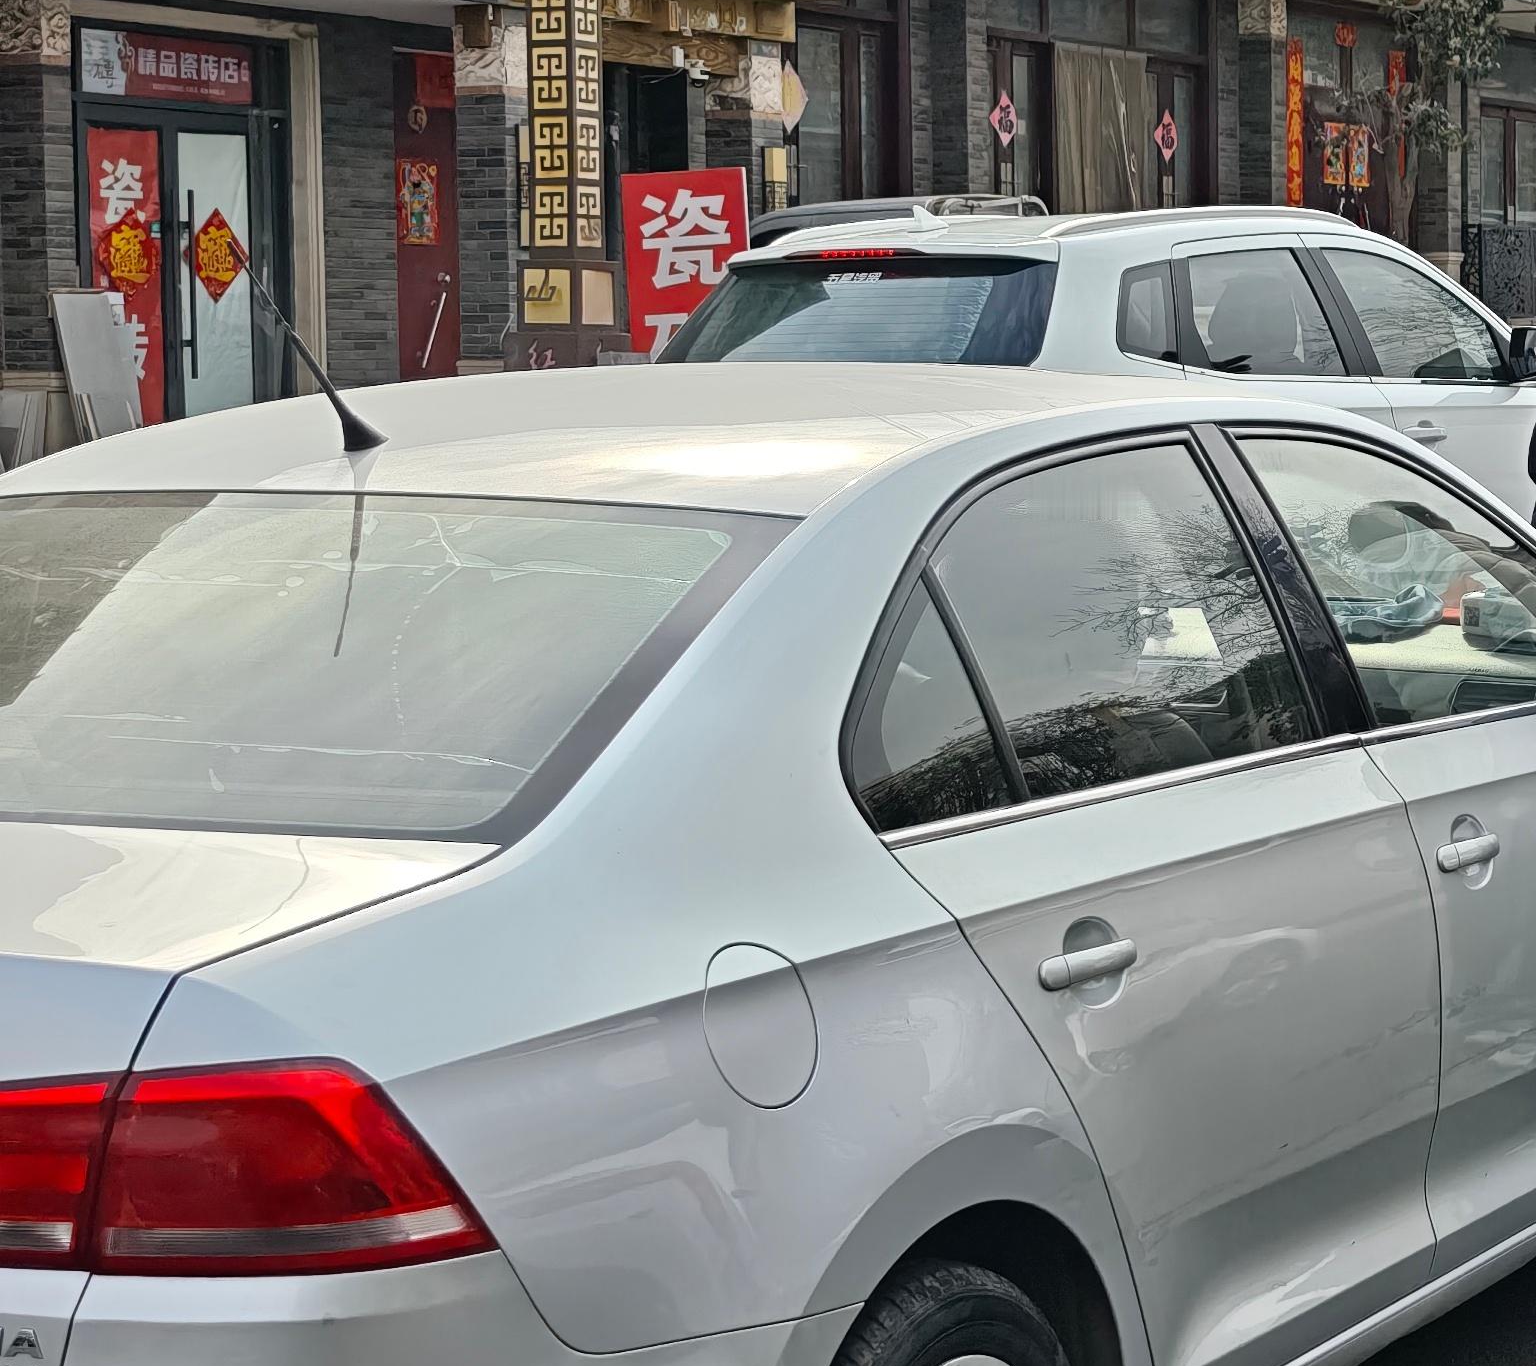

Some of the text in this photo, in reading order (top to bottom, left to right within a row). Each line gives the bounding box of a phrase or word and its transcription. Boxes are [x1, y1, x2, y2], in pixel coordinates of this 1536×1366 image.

[137, 47, 239, 84] 精品瓷砖店
